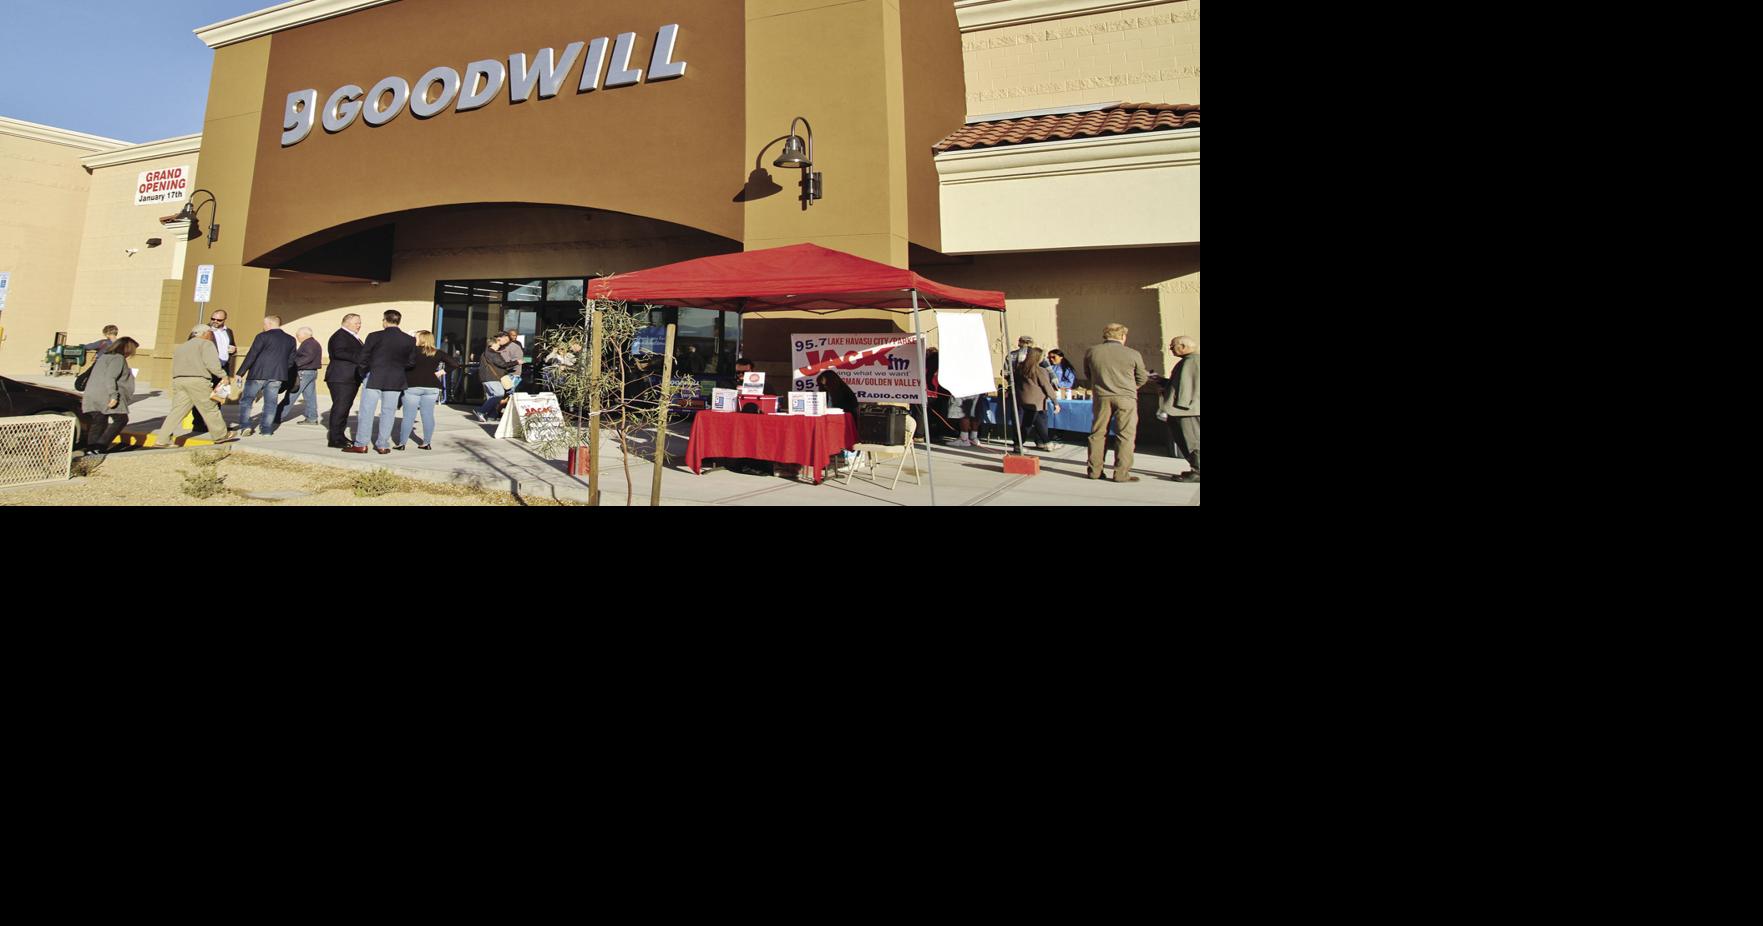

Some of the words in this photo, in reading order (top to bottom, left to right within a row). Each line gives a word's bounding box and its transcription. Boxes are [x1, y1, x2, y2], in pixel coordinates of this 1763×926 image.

[322, 23, 688, 134] GOODWILL
[146, 168, 182, 182] GRAND
[139, 178, 186, 194] OPENING
[139, 194, 165, 202] January
[795, 338, 827, 352] 95.7
[846, 337, 872, 345] HAVASU
[874, 335, 917, 345] CITY/PARKE
[799, 346, 896, 376] JACK
[895, 379, 921, 387] VALLEY
